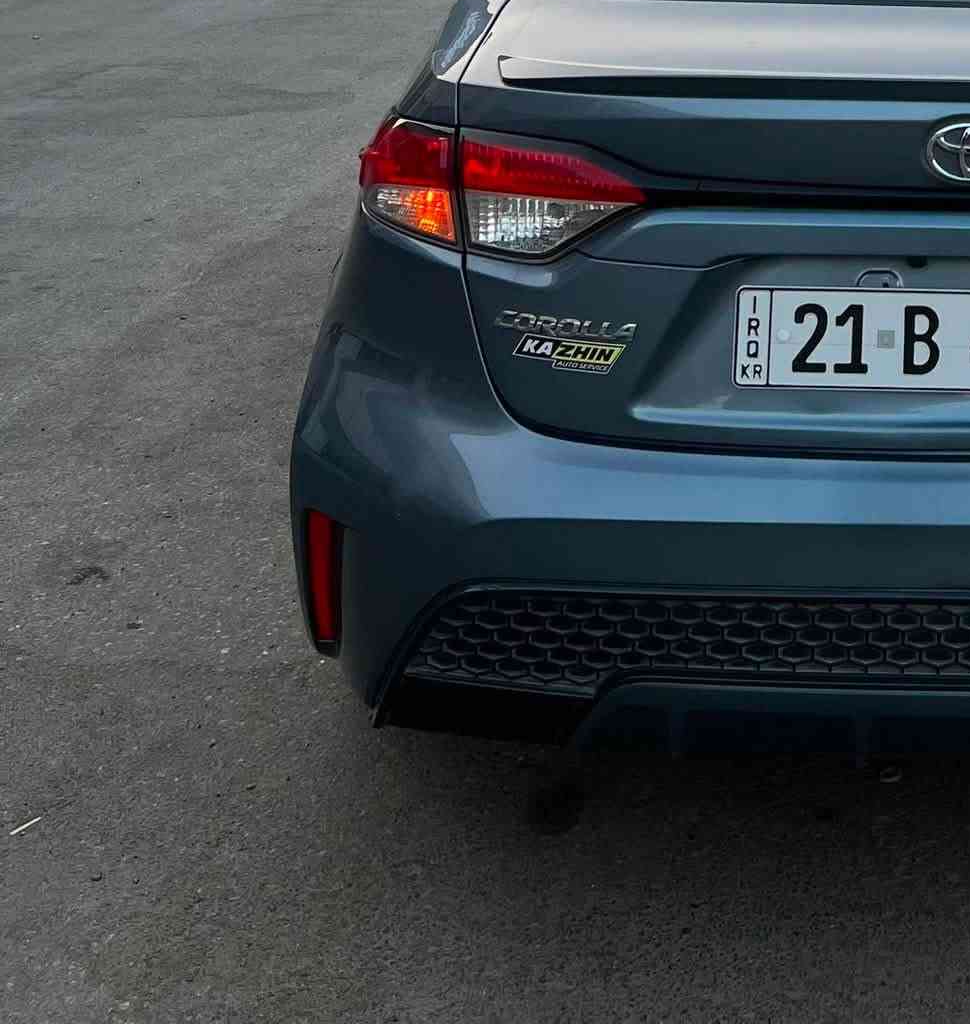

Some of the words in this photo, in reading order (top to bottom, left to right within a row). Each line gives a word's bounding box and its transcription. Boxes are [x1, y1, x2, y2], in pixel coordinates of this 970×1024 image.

[494, 309, 638, 339] COROLLA
[522, 337, 617, 364] KAZHIN
[792, 303, 868, 374] 21
[903, 305, 941, 375] B
[556, 360, 578, 369] AUTO
[579, 361, 609, 372] SERVICE
[740, 363, 763, 380] KR
